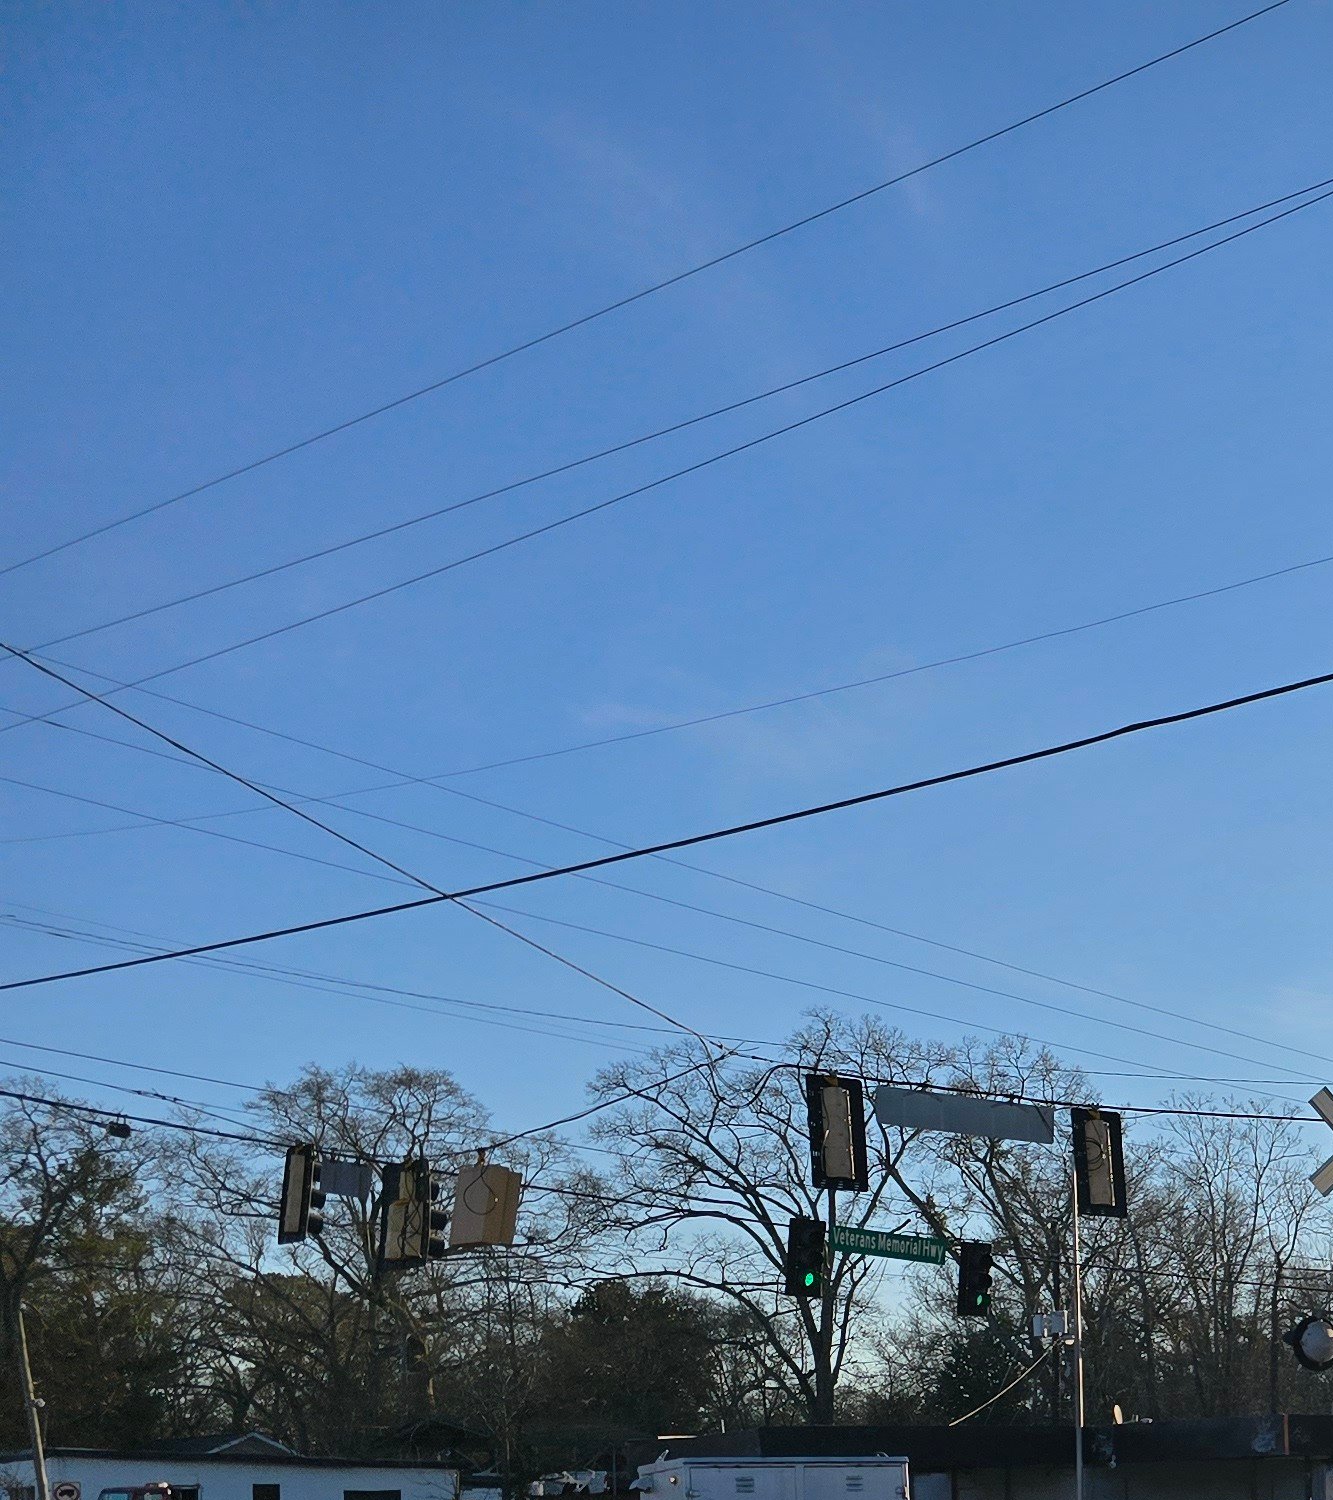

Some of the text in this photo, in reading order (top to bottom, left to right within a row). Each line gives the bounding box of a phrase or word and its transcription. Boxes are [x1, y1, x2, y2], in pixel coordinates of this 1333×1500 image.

[833, 1227, 944, 1262] Veterans Memorial Hwy
